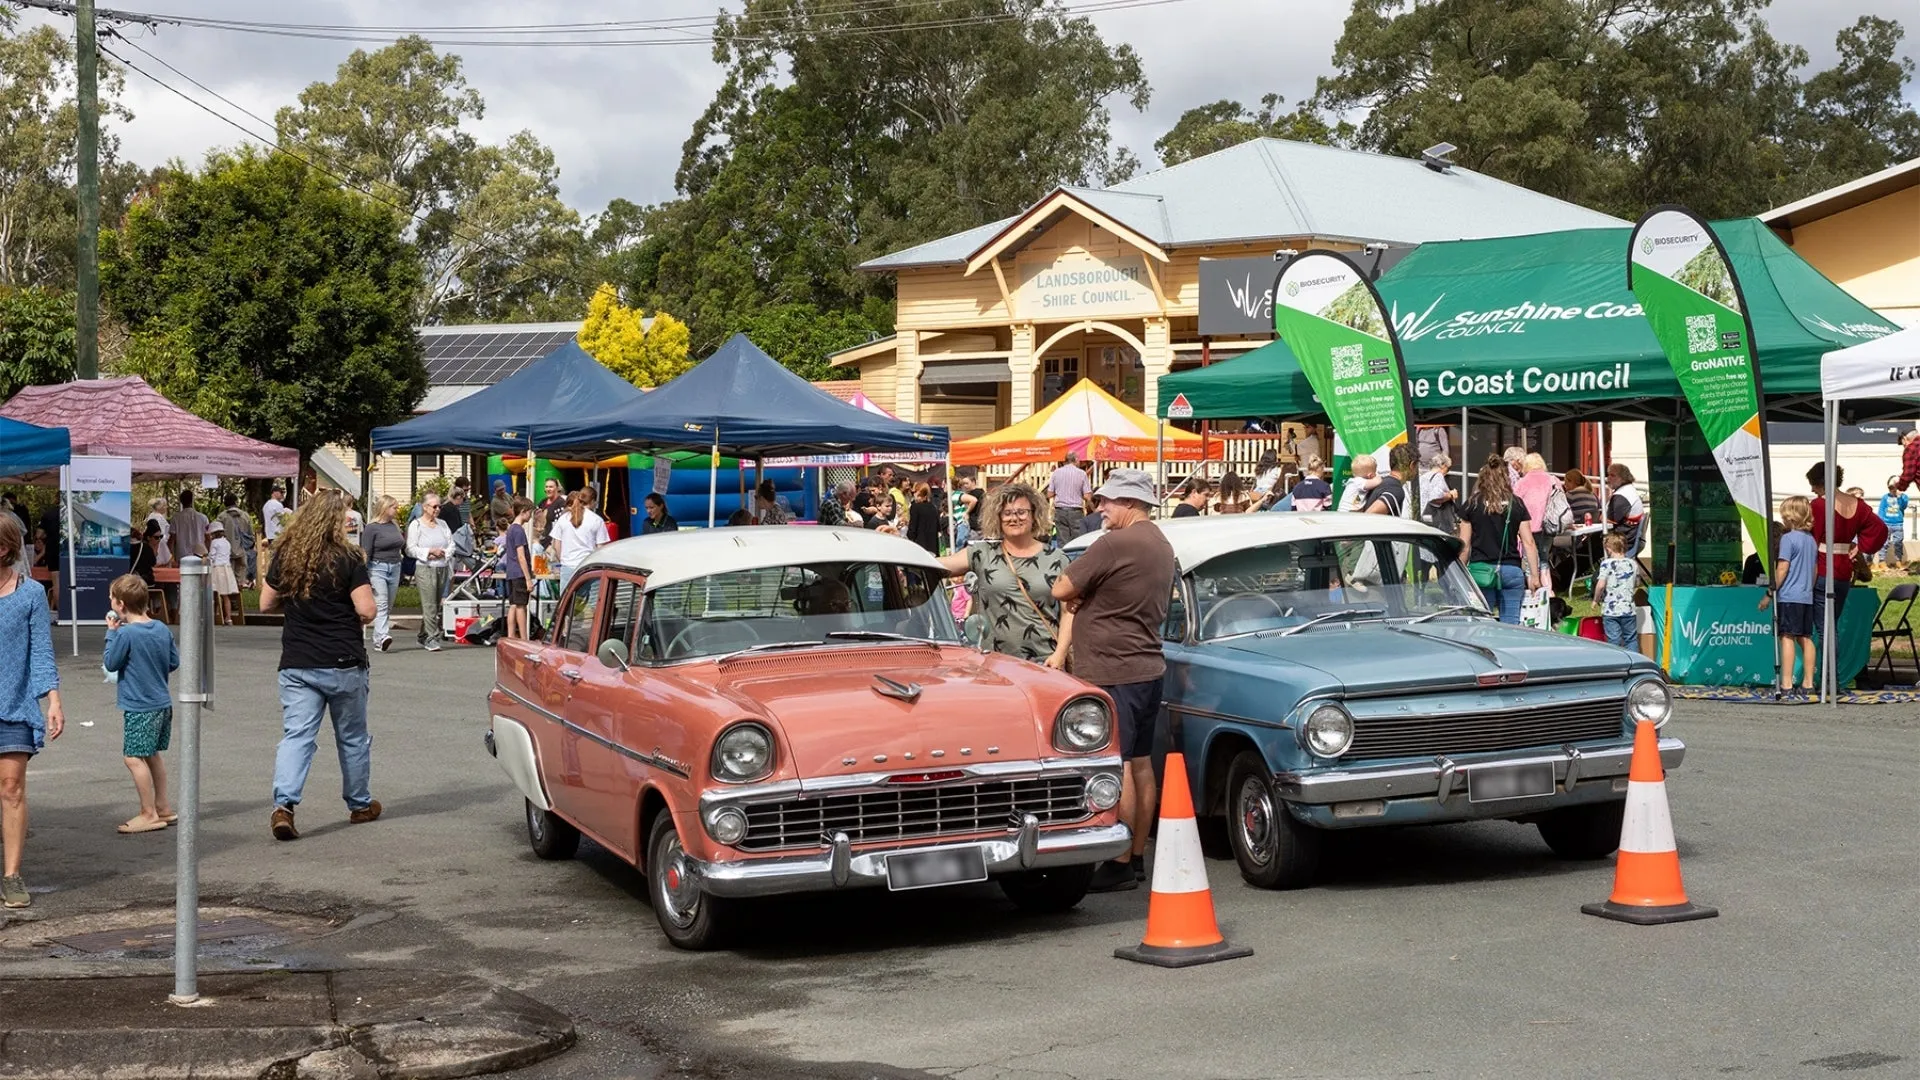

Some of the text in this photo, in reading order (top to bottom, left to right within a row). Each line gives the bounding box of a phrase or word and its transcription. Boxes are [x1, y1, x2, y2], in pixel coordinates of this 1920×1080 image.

[1655, 234, 1698, 246] BIOSECURITY
[1037, 267, 1138, 289] LANDSBOROUGH
[1300, 274, 1347, 288] BIOSECURITY
[1043, 294, 1077, 308] SHIRE
[1447, 301, 1647, 327] Sunshine Coa
[1436, 321, 1526, 340] COUNCIL
[1691, 356, 1745, 371] GroNATIVE
[1438, 369, 1515, 396] Coast
[1523, 362, 1631, 393] Council
[1738, 373, 1748, 381] app
[1335, 379, 1393, 396] GroNATIVE
[1711, 620, 1771, 635] Sunshine
[1709, 636, 1753, 646] COUNCIL
